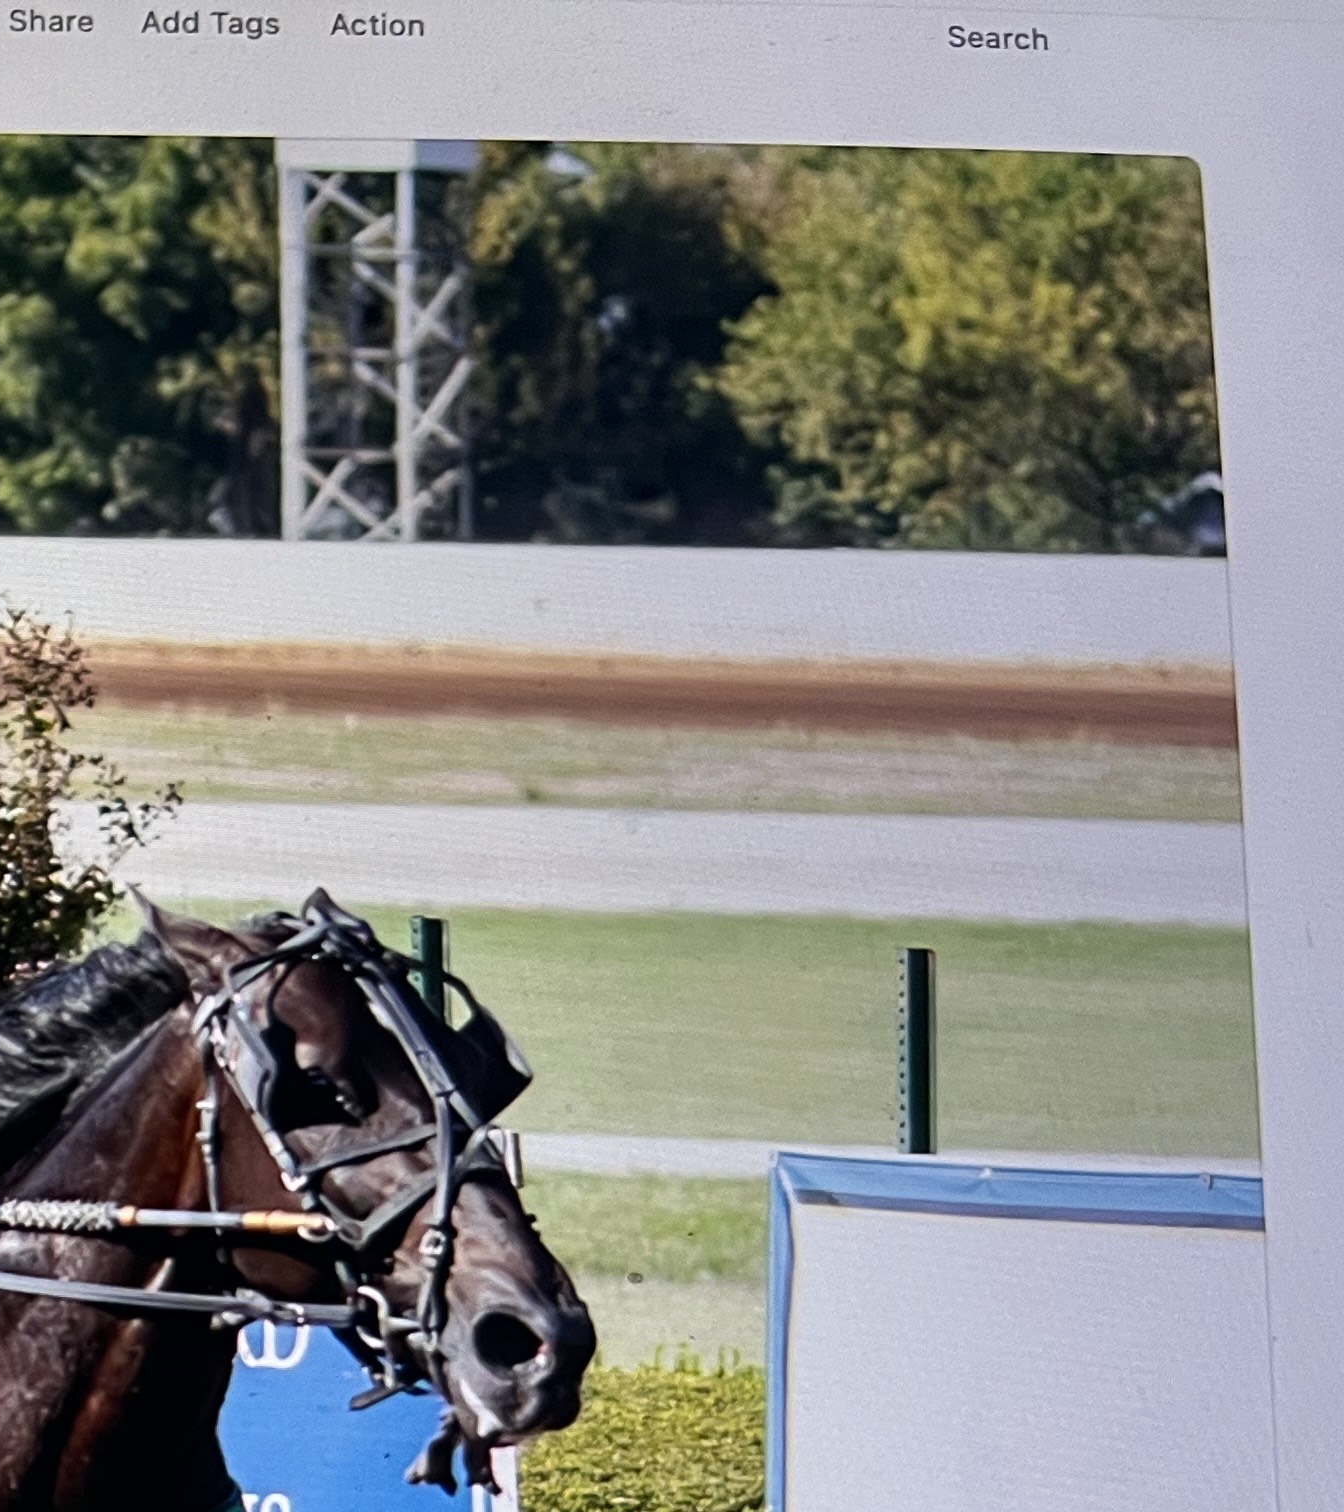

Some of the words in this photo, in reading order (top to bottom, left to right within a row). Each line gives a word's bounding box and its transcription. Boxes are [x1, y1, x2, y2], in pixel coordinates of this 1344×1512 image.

[9, 9, 94, 32] Share
[141, 10, 200, 34] Add
[210, 11, 280, 40] Tags
[330, 13, 425, 36] Action
[947, 24, 1050, 51] Search
